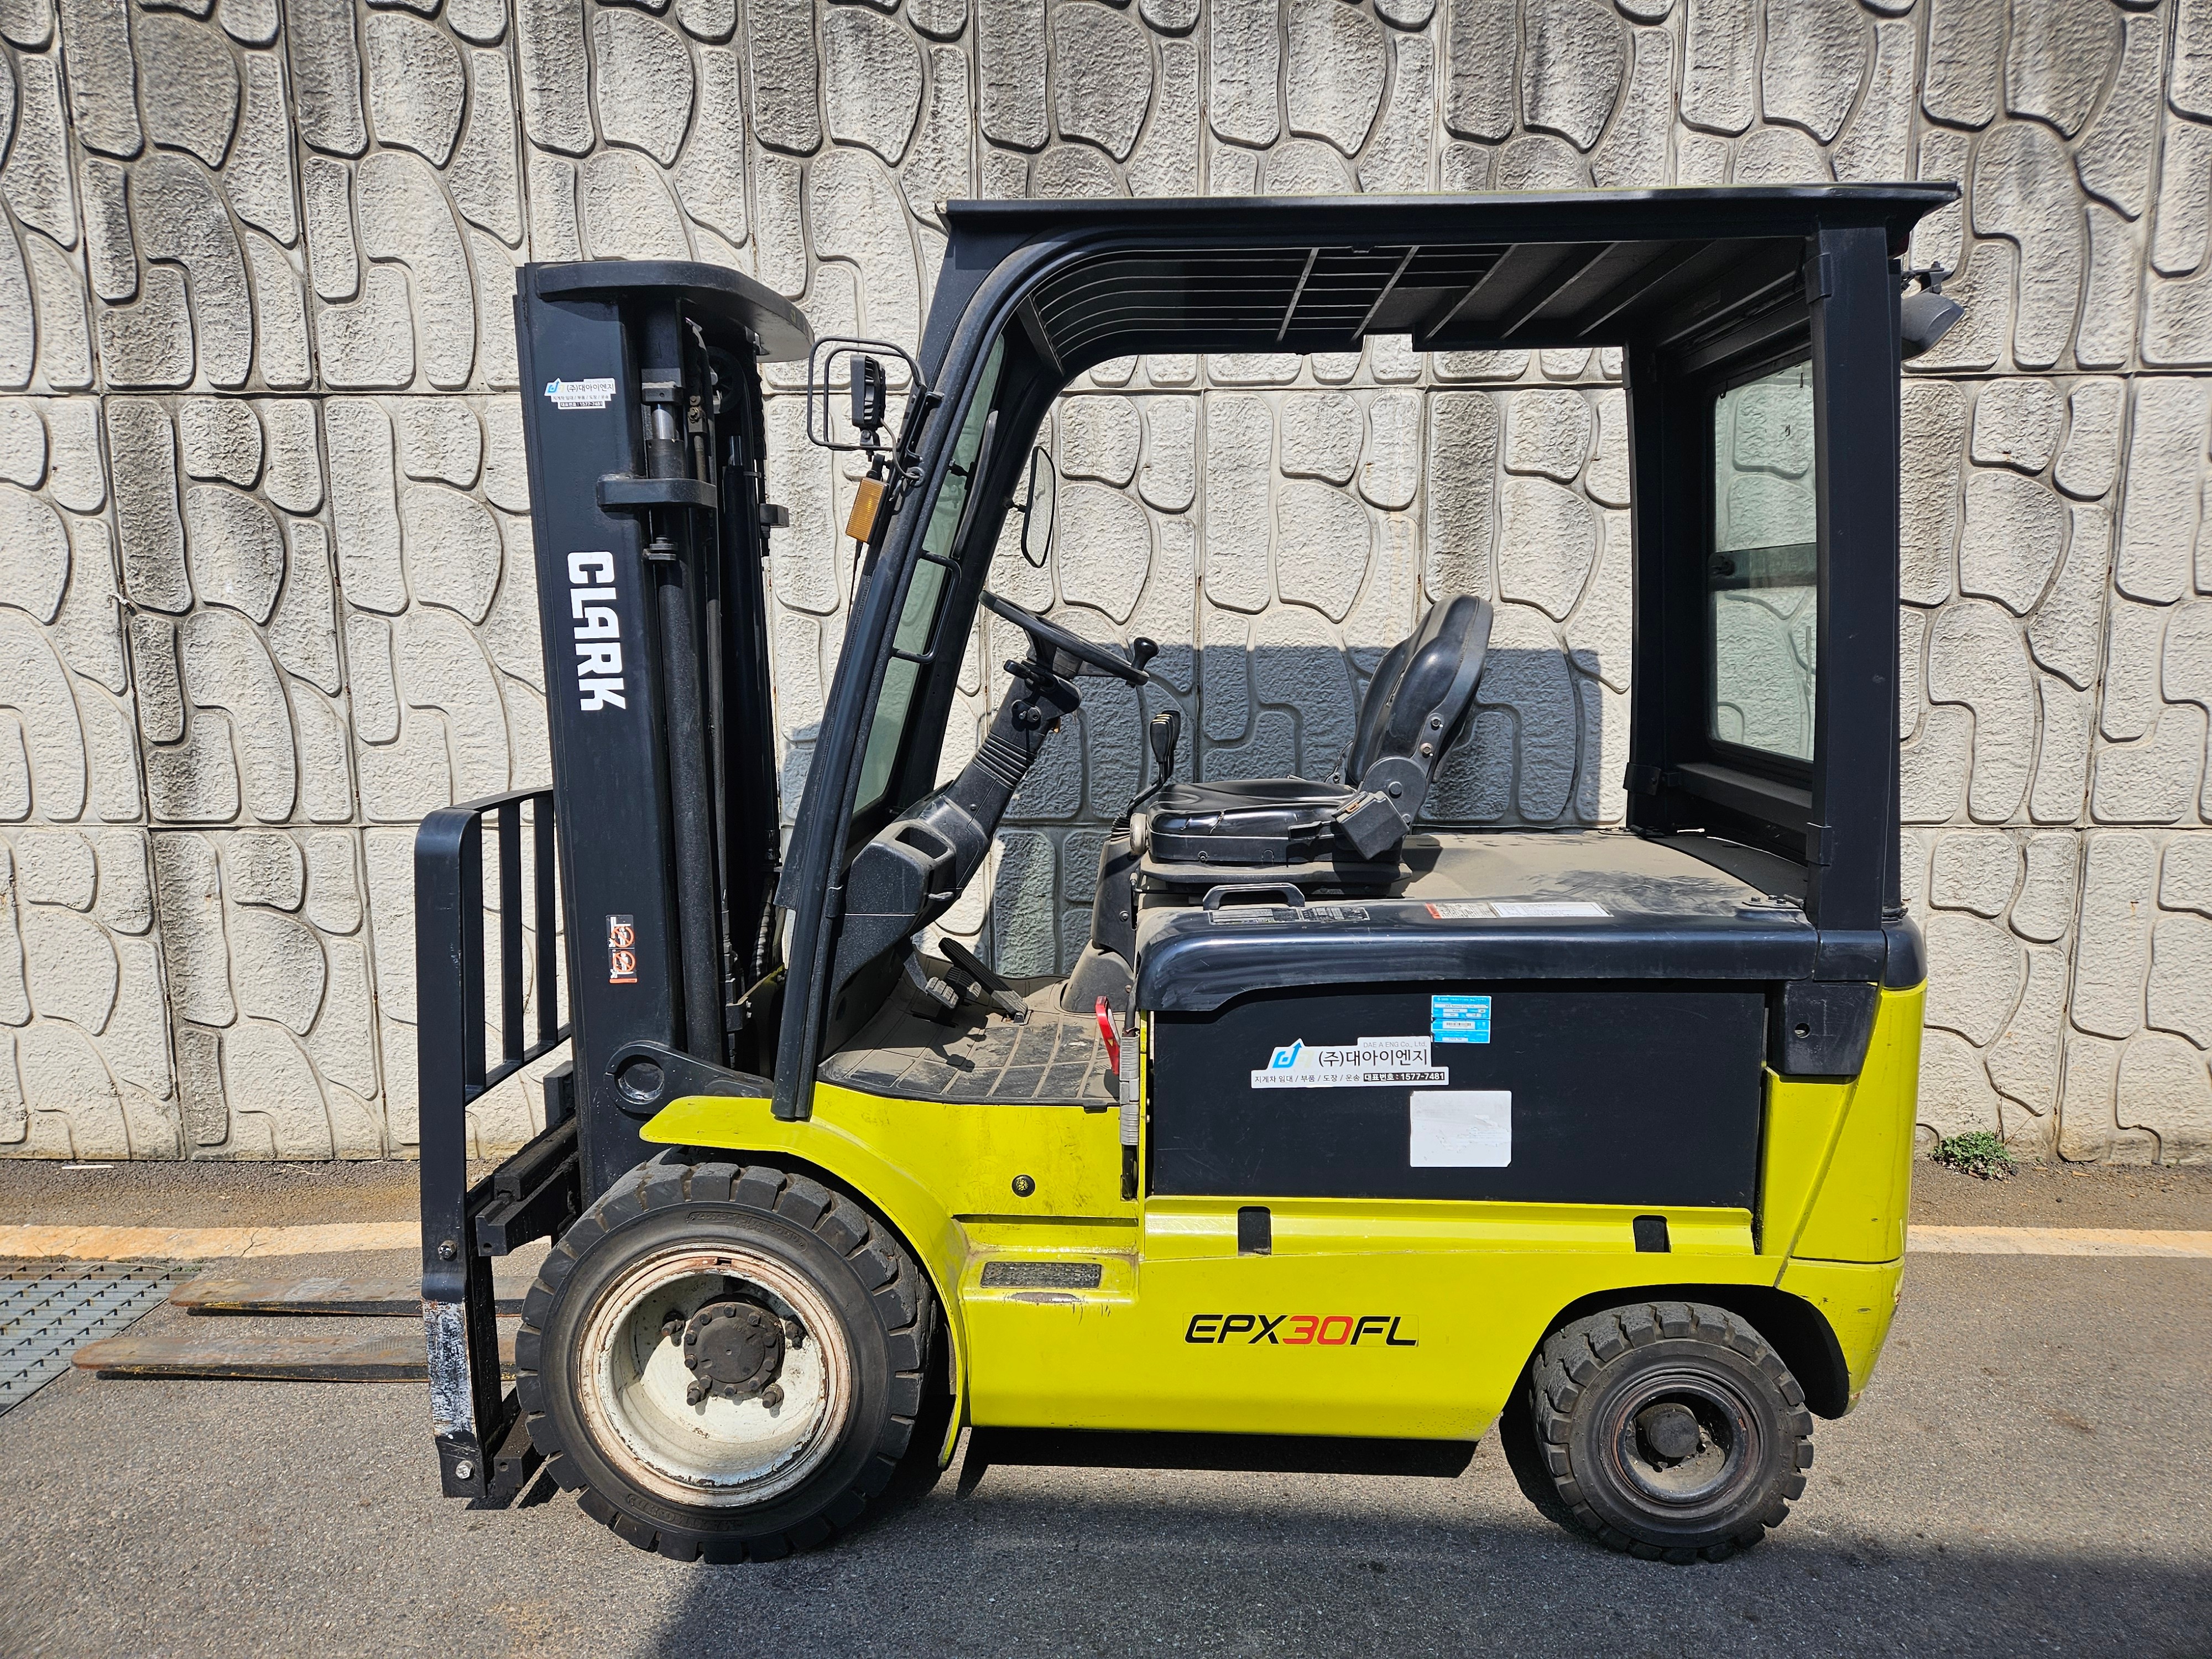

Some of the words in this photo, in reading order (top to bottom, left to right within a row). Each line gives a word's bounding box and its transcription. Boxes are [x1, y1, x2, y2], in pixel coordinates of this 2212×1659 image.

[567, 383, 614, 392] (주)대아이엔지
[567, 551, 626, 711] CLARK
[1319, 1049, 1427, 1067] (주)대아이엔지
[1400, 1072, 1444, 1081] 1577-7481
[1185, 1314, 1417, 1346] EPX30FL
